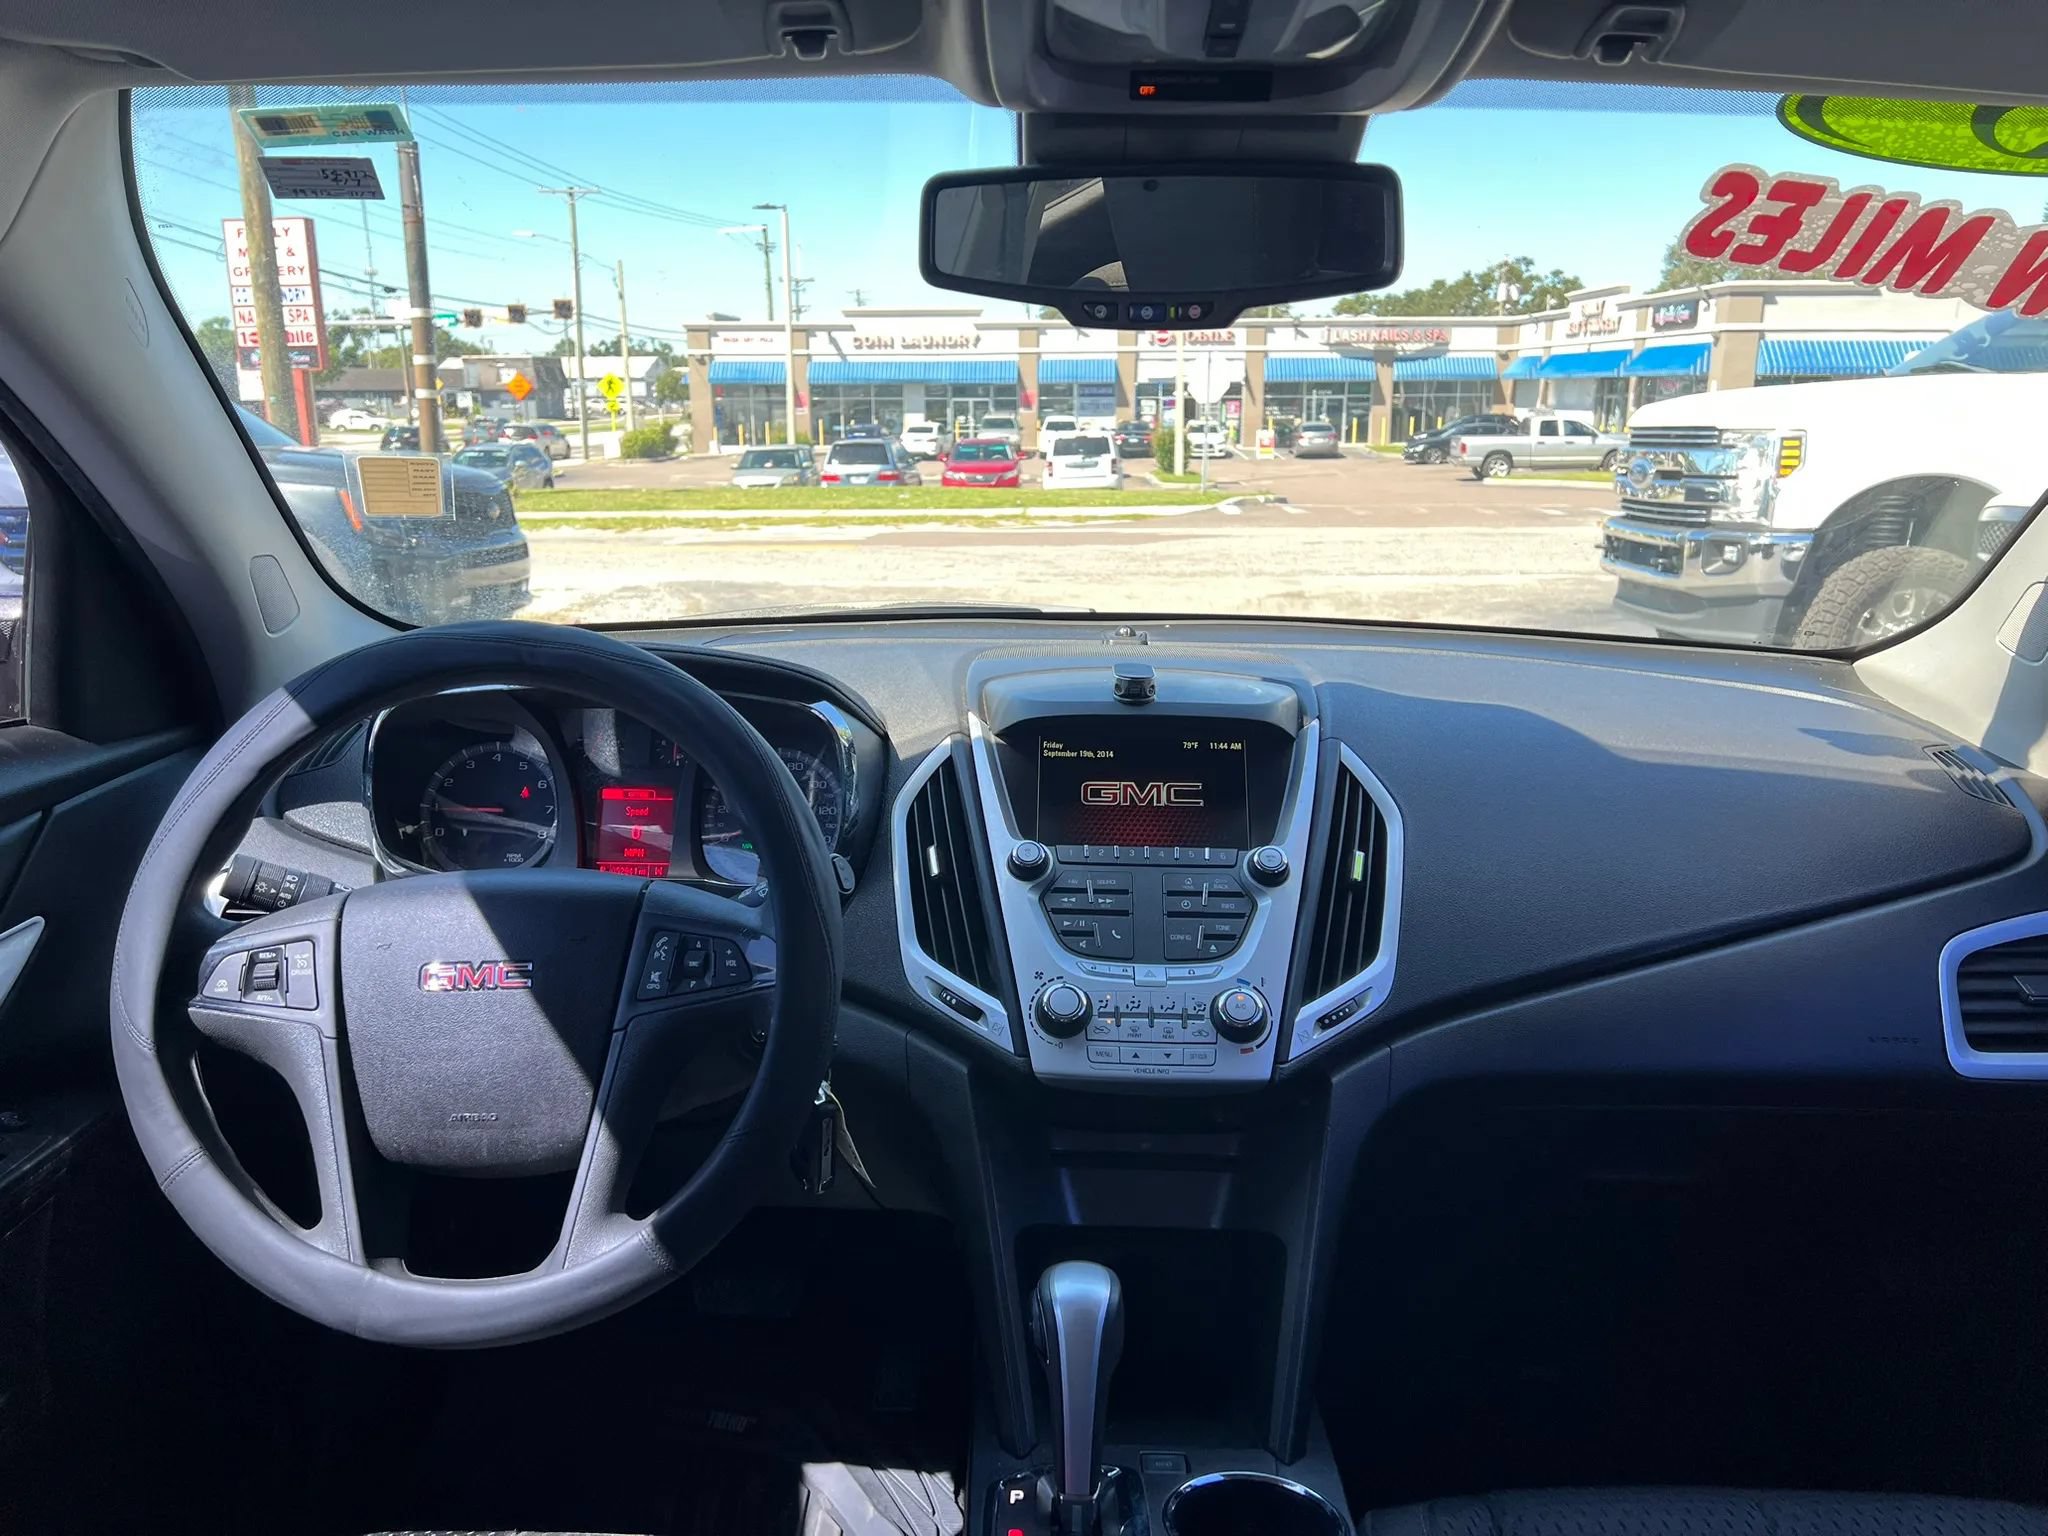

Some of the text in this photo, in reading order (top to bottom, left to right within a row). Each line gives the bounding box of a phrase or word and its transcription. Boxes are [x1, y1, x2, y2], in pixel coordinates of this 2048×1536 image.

[1139, 86, 1156, 95] OFF
[332, 128, 406, 138] CAR WASH
[236, 227, 291, 238] FLY
[288, 308, 310, 322] SPA
[1369, 328, 1408, 342] NAILS
[1425, 328, 1450, 342] SPA
[853, 335, 895, 350] COIN
[1043, 741, 1064, 750] Friday
[1209, 742, 1229, 750] 11:44
[1230, 742, 1242, 750] AM
[492, 753, 501, 762] 4
[1043, 749, 1078, 759] September
[1097, 750, 1114, 758] 2014
[466, 761, 475, 769] 3
[519, 761, 528, 770] 5
[444, 778, 454, 787] 2
[538, 780, 547, 789] 6
[1081, 781, 1204, 807] GMC
[545, 805, 554, 814] 7
[625, 806, 649, 817] Speed
[818, 806, 836, 815] 120
[434, 827, 445, 838] 0
[537, 830, 547, 839] 8
[631, 825, 641, 840] 0
[418, 961, 533, 991] GMC
[1095, 1050, 1113, 1058] MENU
[448, 1112, 499, 1122] AIRBAG
[1009, 1489, 1025, 1505] P
